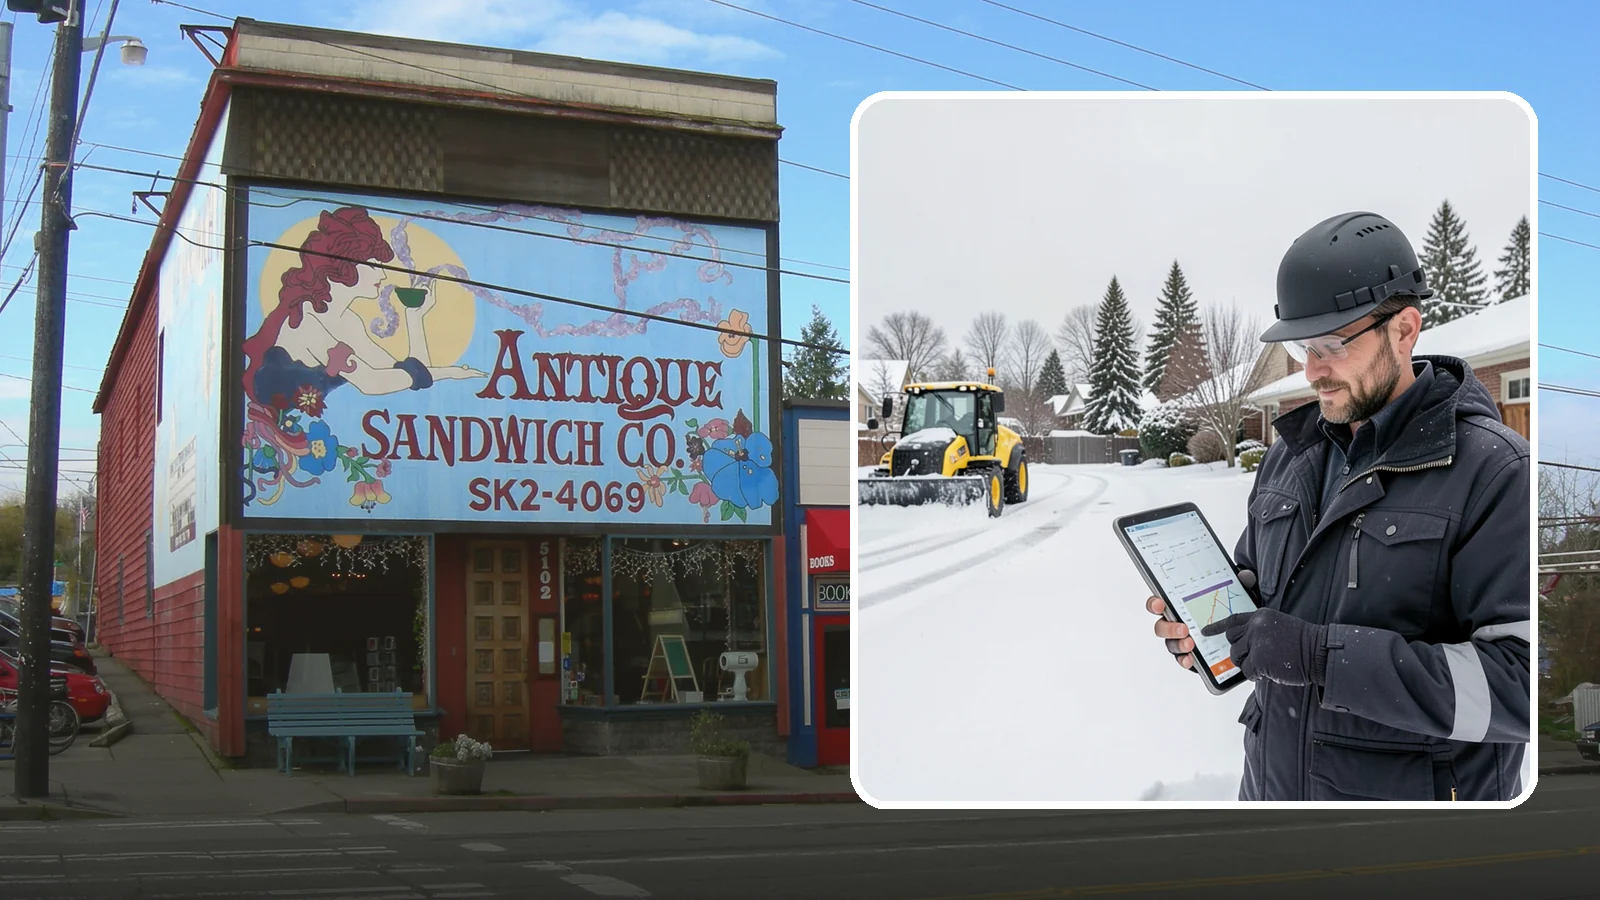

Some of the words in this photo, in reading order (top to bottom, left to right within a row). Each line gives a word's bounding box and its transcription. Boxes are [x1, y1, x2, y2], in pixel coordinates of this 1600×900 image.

[476, 328, 723, 420] ANTIQUE
[361, 408, 605, 467] SANDWICH
[617, 421, 686, 468] CO.
[468, 477, 646, 513] SK2-4069
[540, 541, 552, 600] 5102
[809, 555, 835, 569] BOOKS
